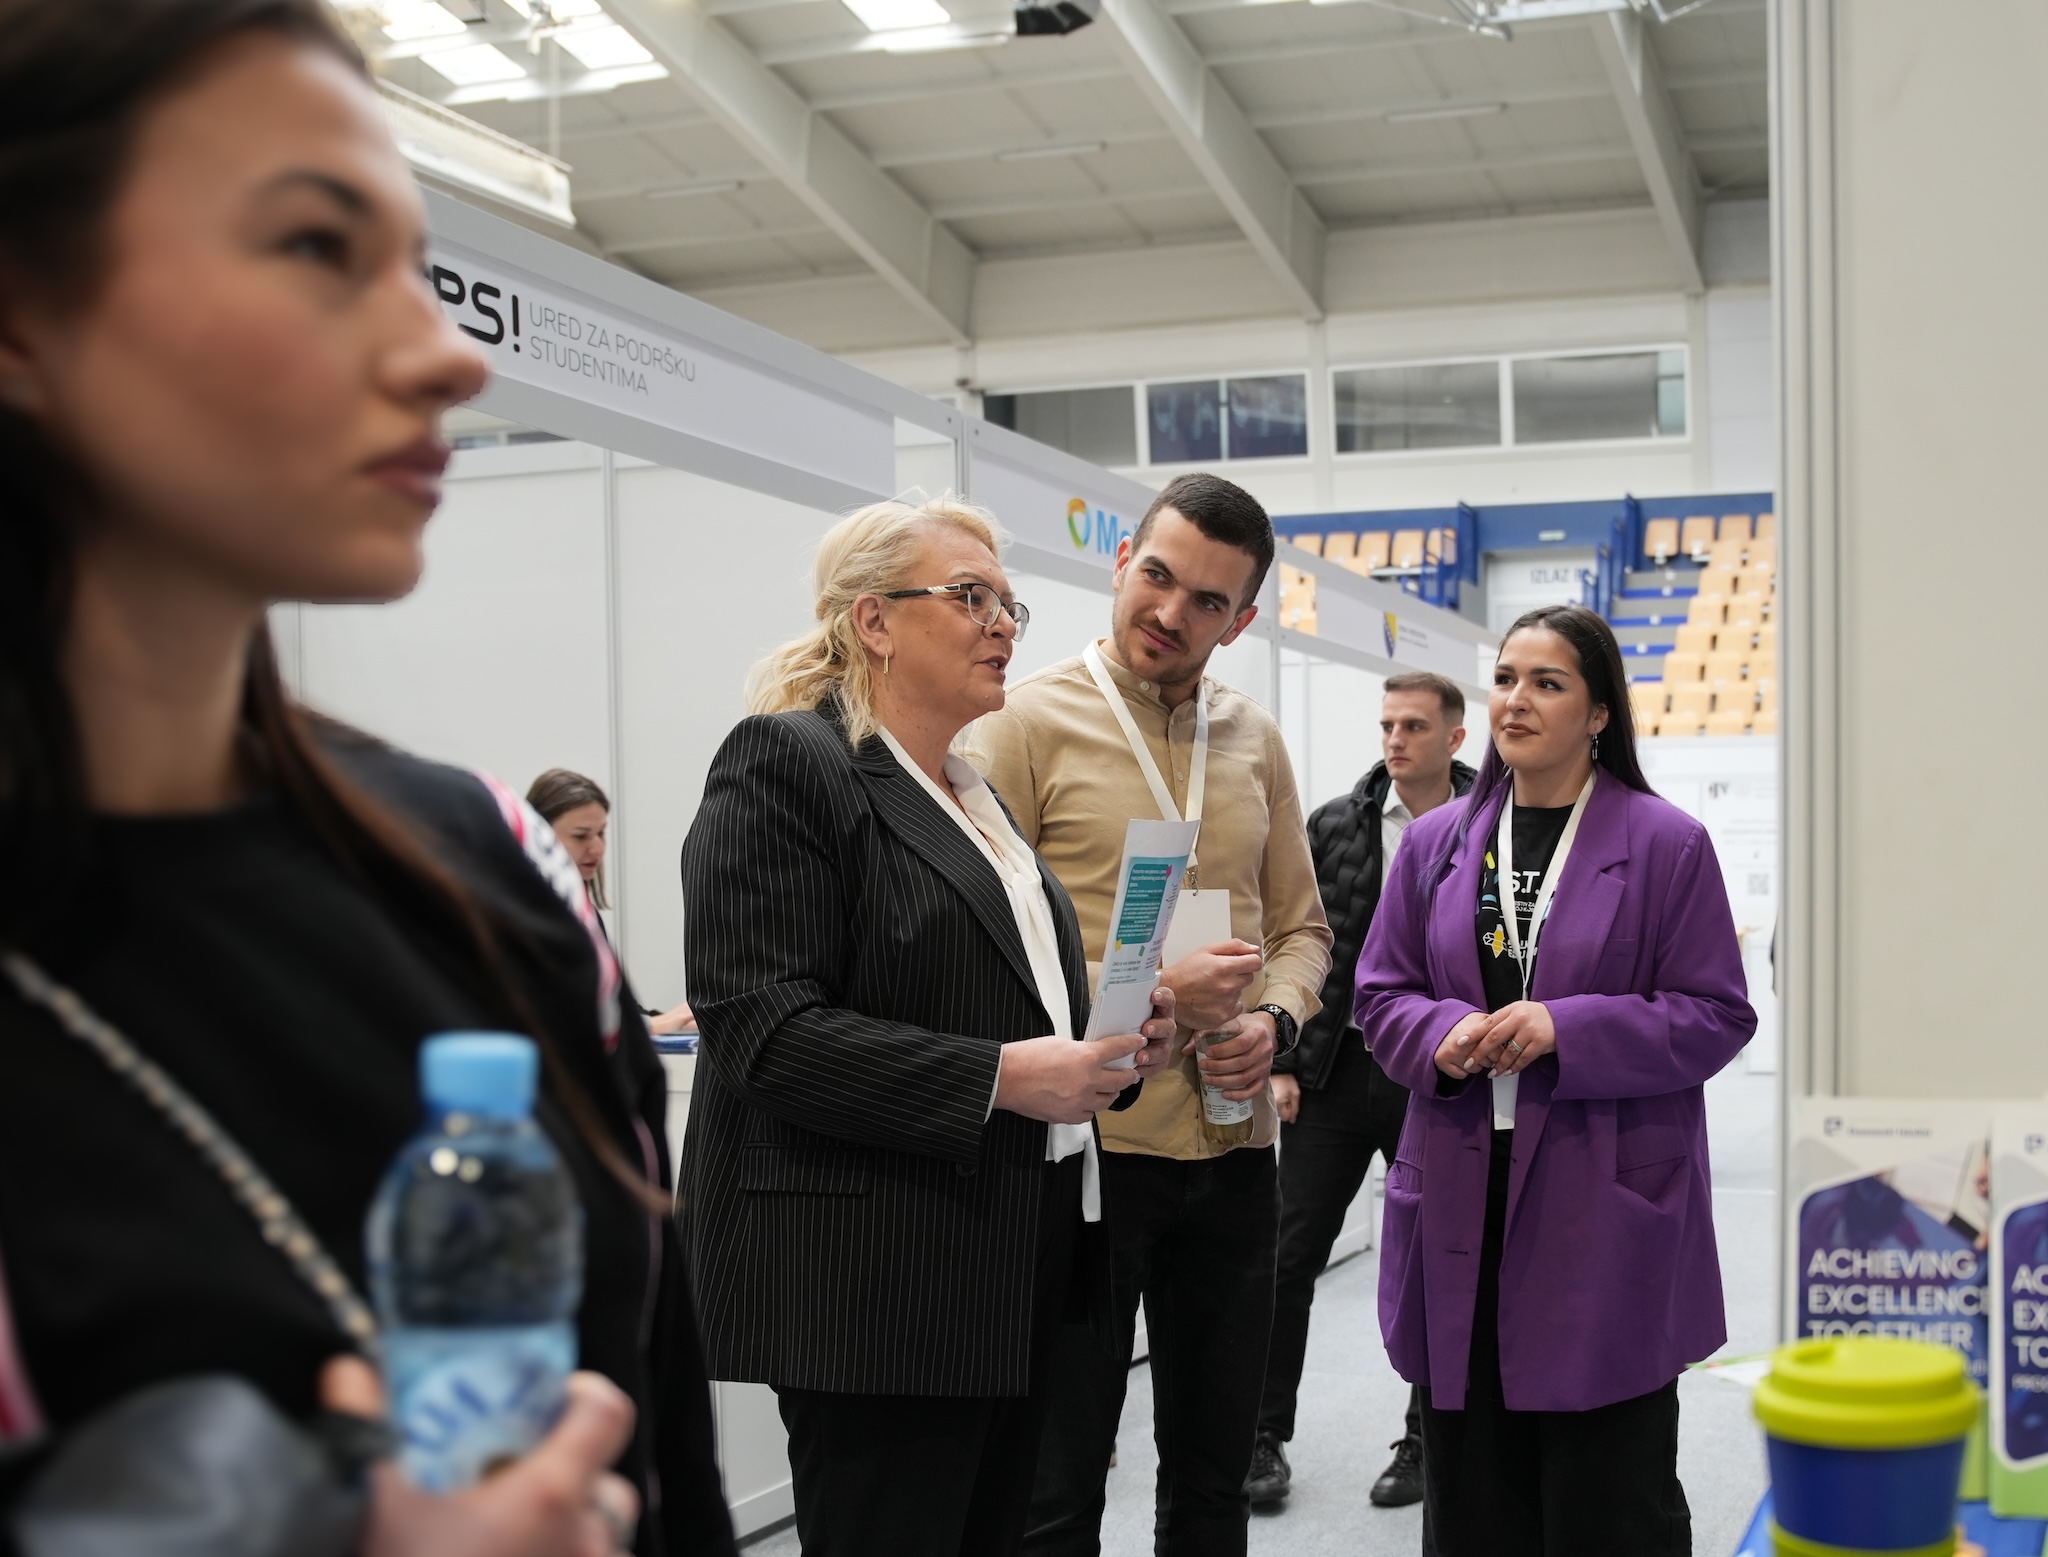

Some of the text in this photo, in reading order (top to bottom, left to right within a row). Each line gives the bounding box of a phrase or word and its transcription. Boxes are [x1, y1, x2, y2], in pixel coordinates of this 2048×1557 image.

[430, 264, 520, 353] PS!
[530, 302, 697, 382] URED ZA PODRŠKU
[530, 336, 649, 396] STUDENTIMA
[1530, 567, 1569, 584] IZLAZ
[1807, 1248, 1978, 1279] ACHIEVING
